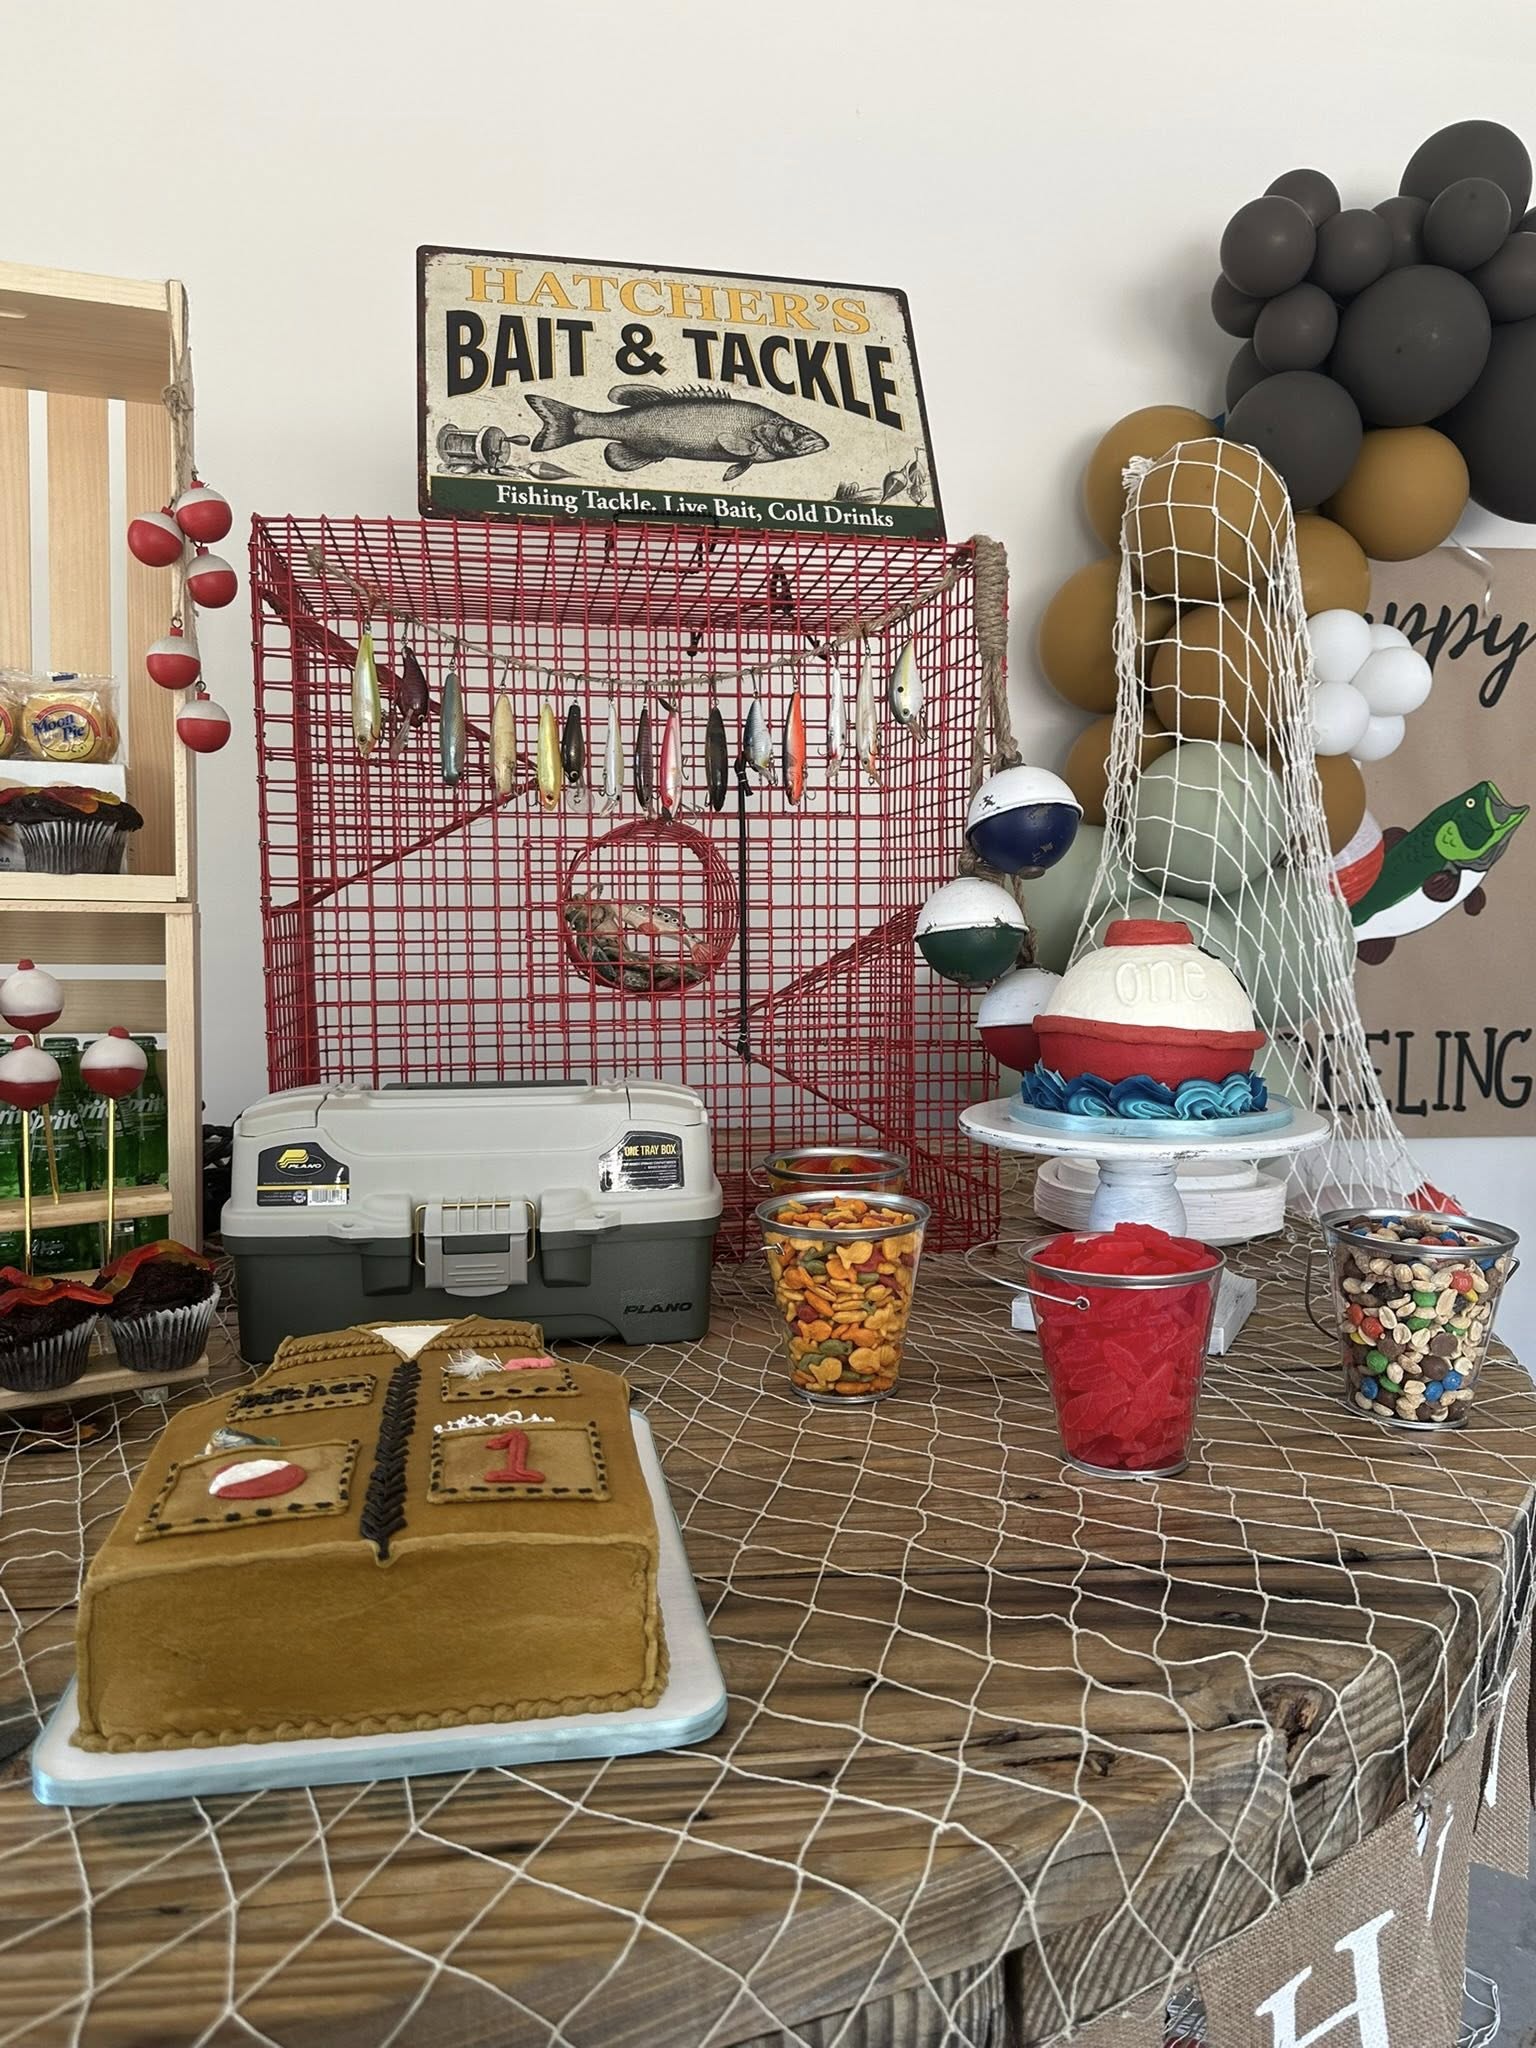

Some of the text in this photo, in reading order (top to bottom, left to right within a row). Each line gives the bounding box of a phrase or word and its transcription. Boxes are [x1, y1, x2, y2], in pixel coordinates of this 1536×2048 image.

[465, 265, 871, 335] HATCHER'S
[446, 309, 905, 432] BAIT & TACKLE
[496, 484, 579, 514] Fishing
[713, 498, 763, 522] Bait,
[767, 501, 820, 524] Cold
[823, 504, 894, 527] Drinks
[32, 714, 75, 737] Moon
[62, 724, 86, 742] Pie
[1114, 960, 1209, 1007] one
[624, 1143, 677, 1157] ONE TRAY BOX
[623, 1302, 693, 1315] PLANO
[483, 1427, 546, 1484] 1
